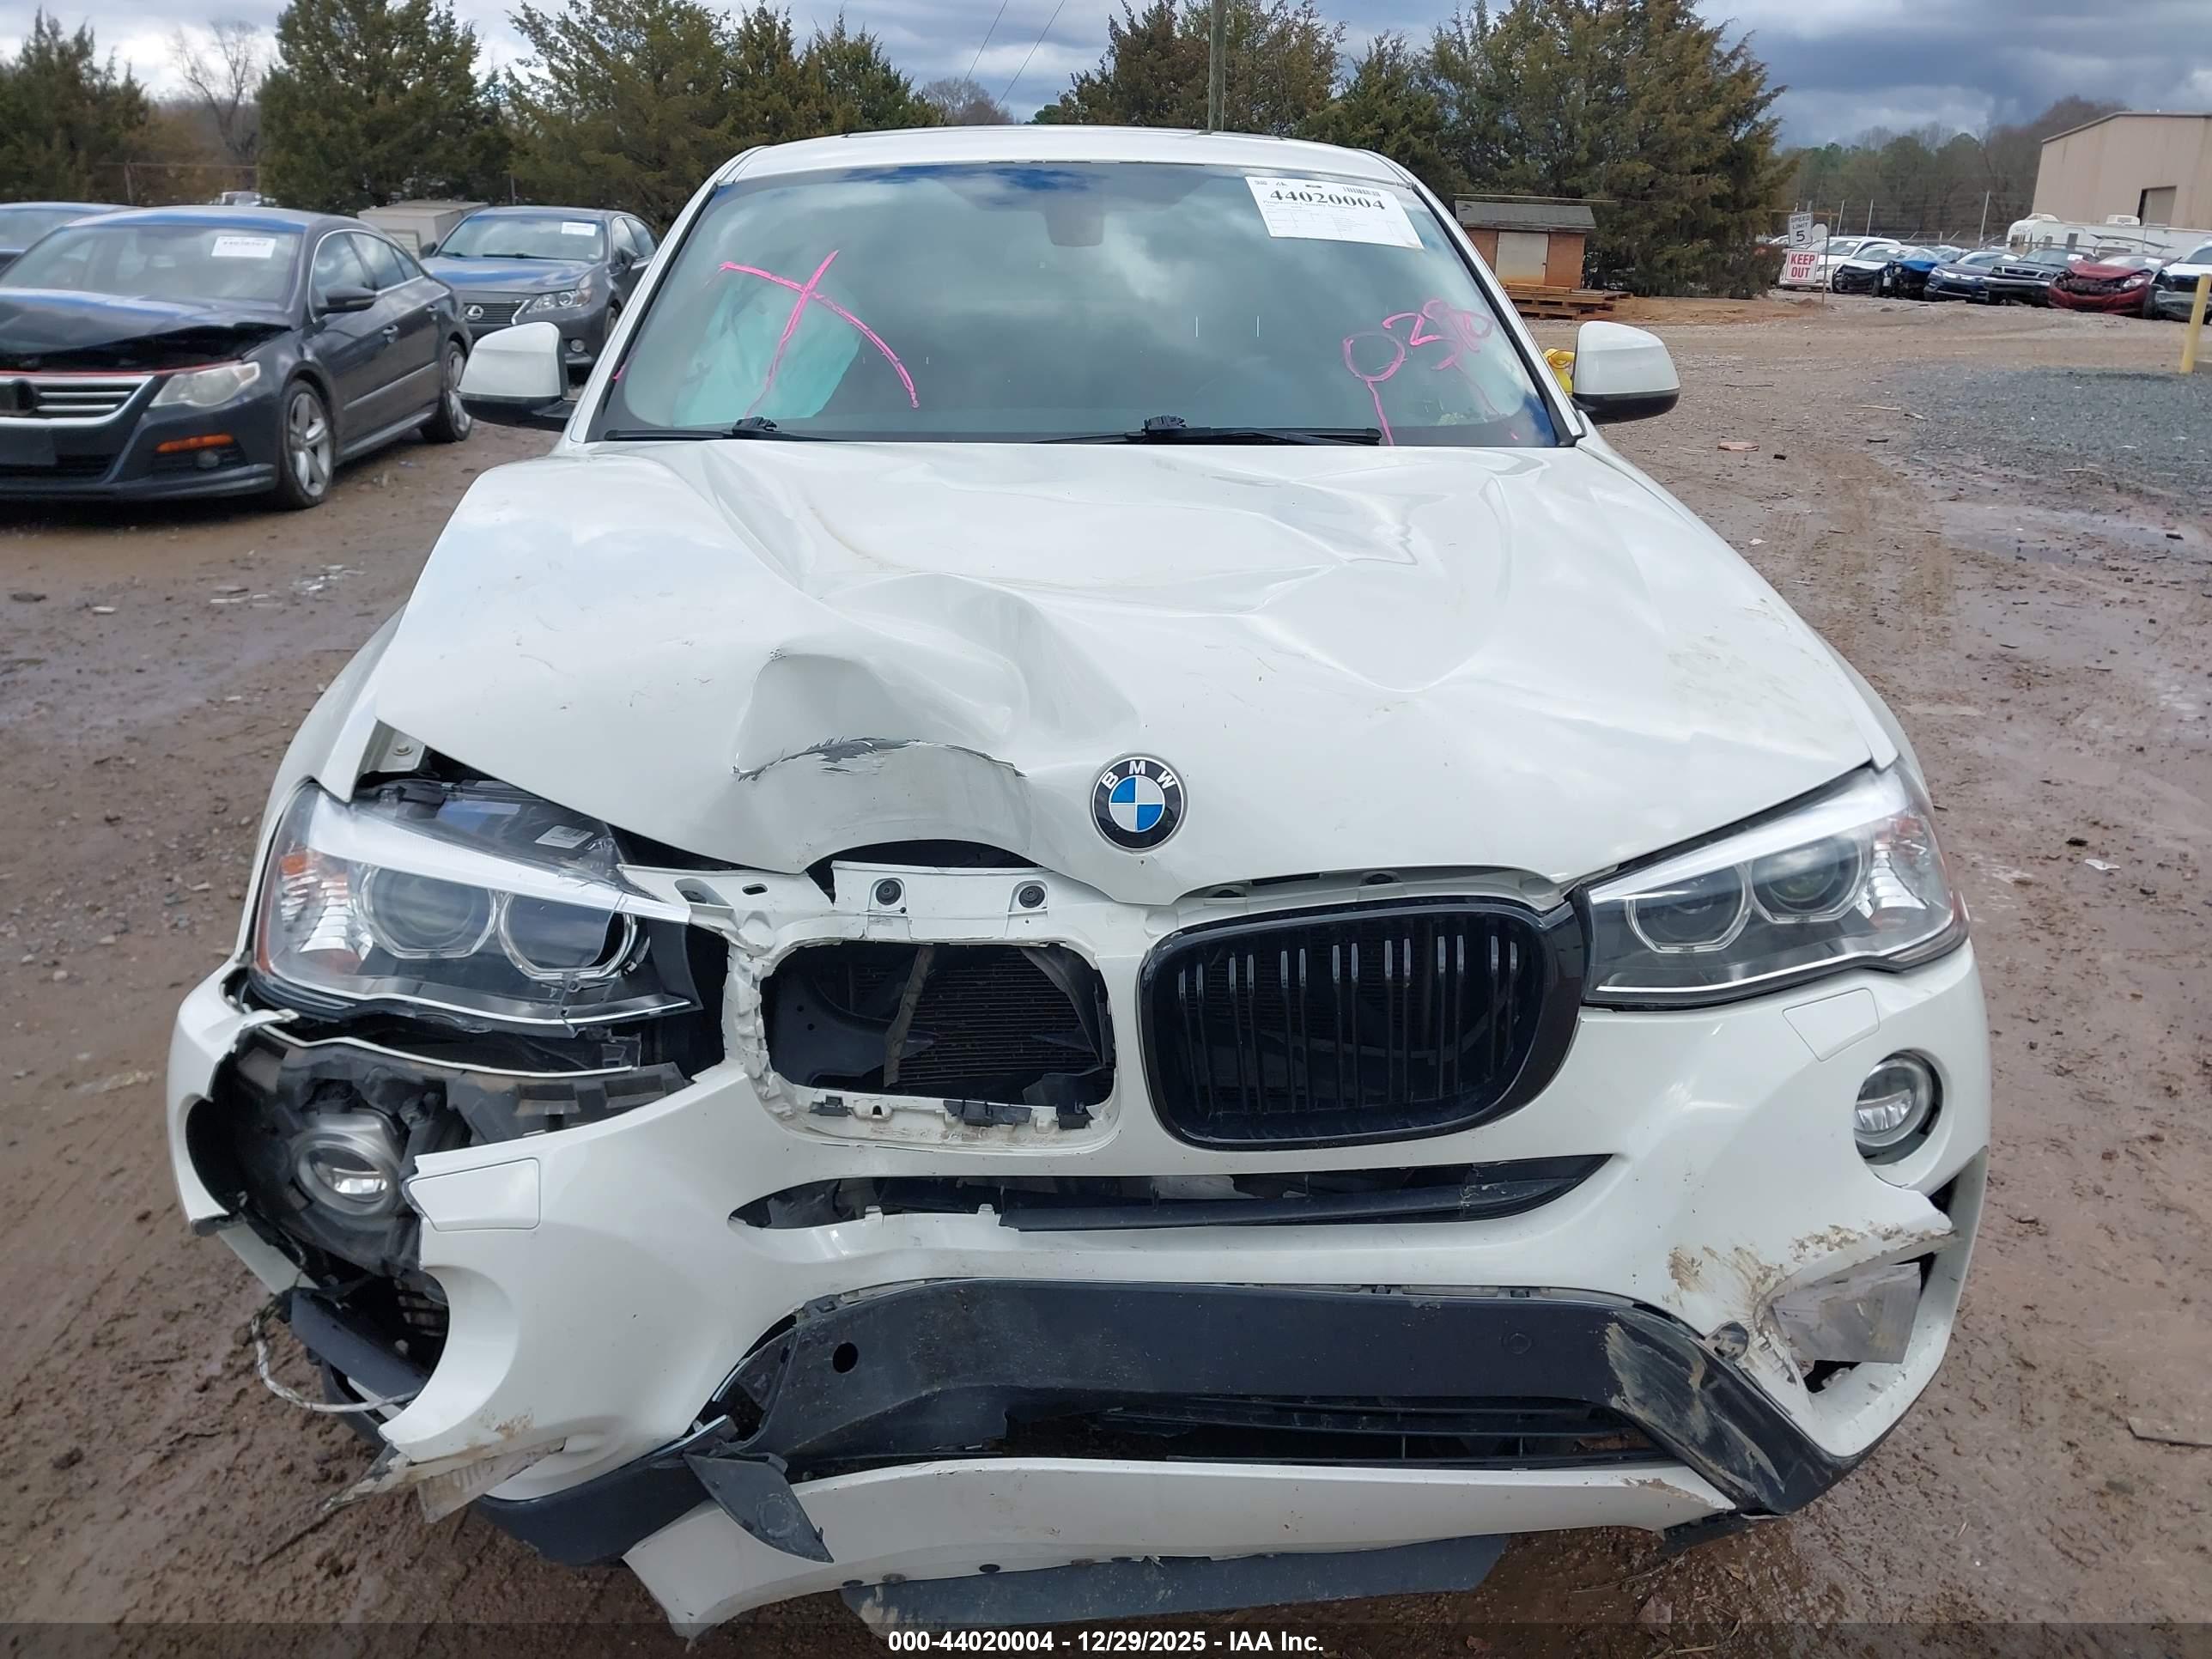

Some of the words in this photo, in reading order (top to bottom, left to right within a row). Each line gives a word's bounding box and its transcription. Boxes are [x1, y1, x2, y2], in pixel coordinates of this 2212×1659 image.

[1270, 189, 1386, 210] 44020004
[1790, 215, 1810, 223] SPEED
[1796, 230, 1806, 242] 5
[1790, 253, 1815, 265] KEEP
[1791, 266, 1811, 278] OUT
[1101, 760, 1176, 790] BMW
